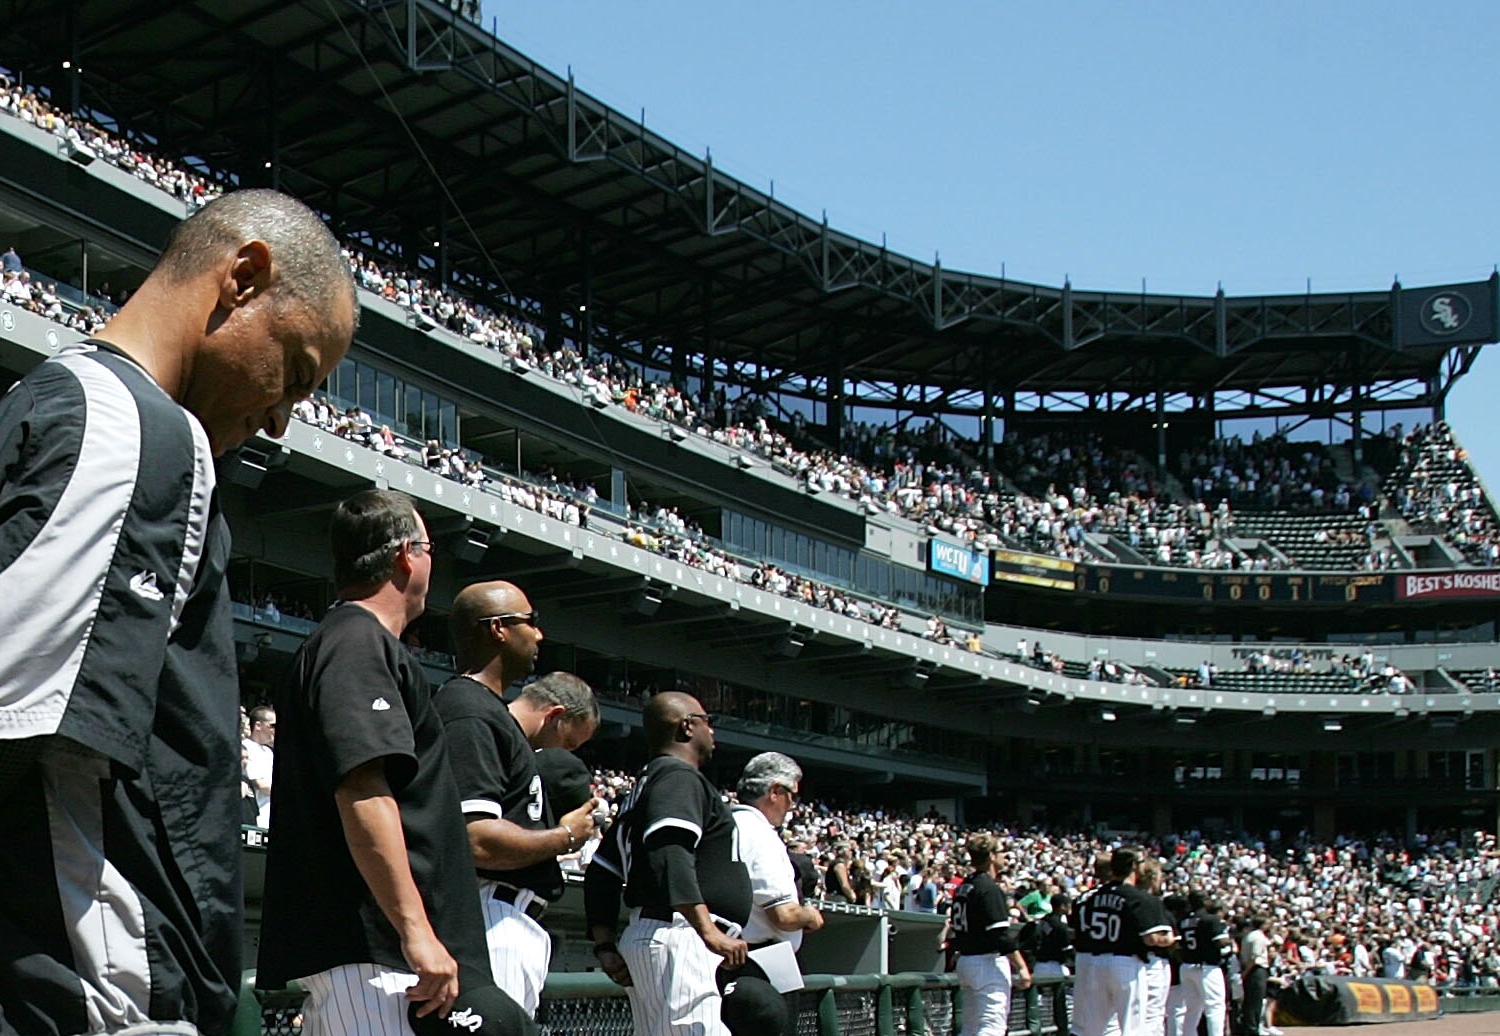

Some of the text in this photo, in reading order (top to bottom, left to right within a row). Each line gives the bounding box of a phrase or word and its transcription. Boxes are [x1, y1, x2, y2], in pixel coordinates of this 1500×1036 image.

[1406, 573, 1500, 597] BEST'S KOSHE
[1090, 911, 1121, 943] 50
